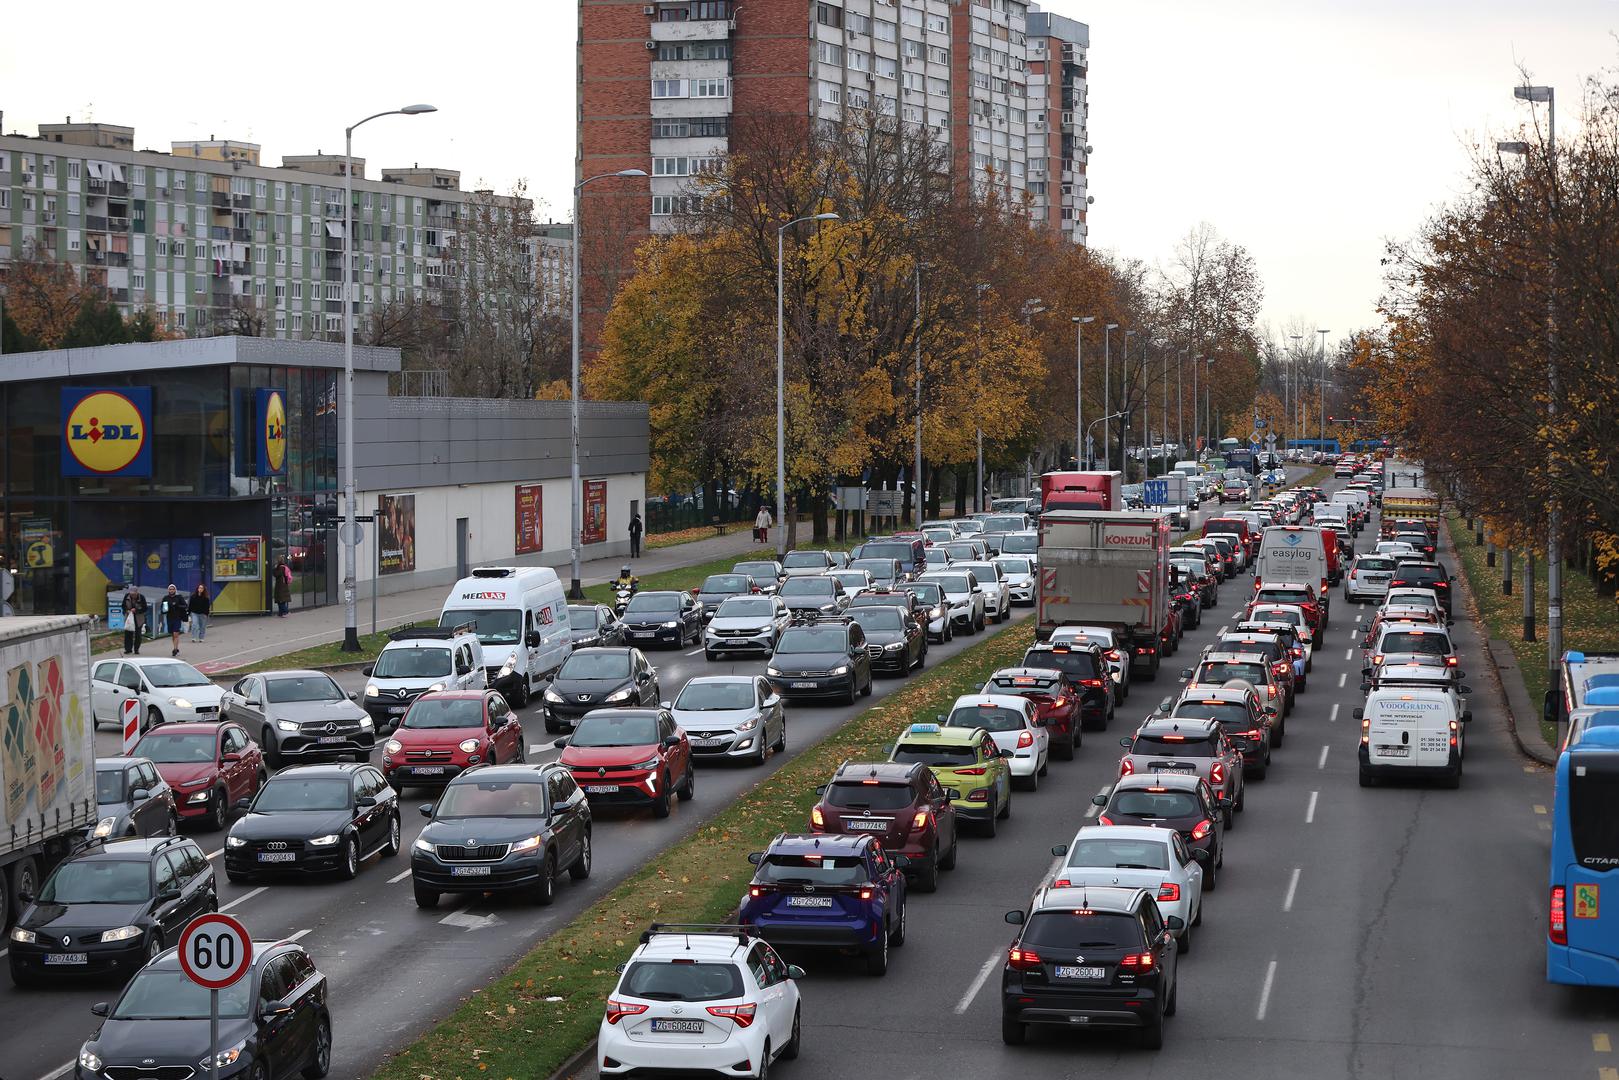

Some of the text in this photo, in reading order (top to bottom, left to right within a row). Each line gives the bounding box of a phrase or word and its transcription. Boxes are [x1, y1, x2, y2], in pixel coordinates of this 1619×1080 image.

[1105, 535, 1150, 545] KONZUM
[1272, 549, 1312, 560] easylog
[194, 933, 234, 970] 60
[657, 1022, 667, 1030] ZG
